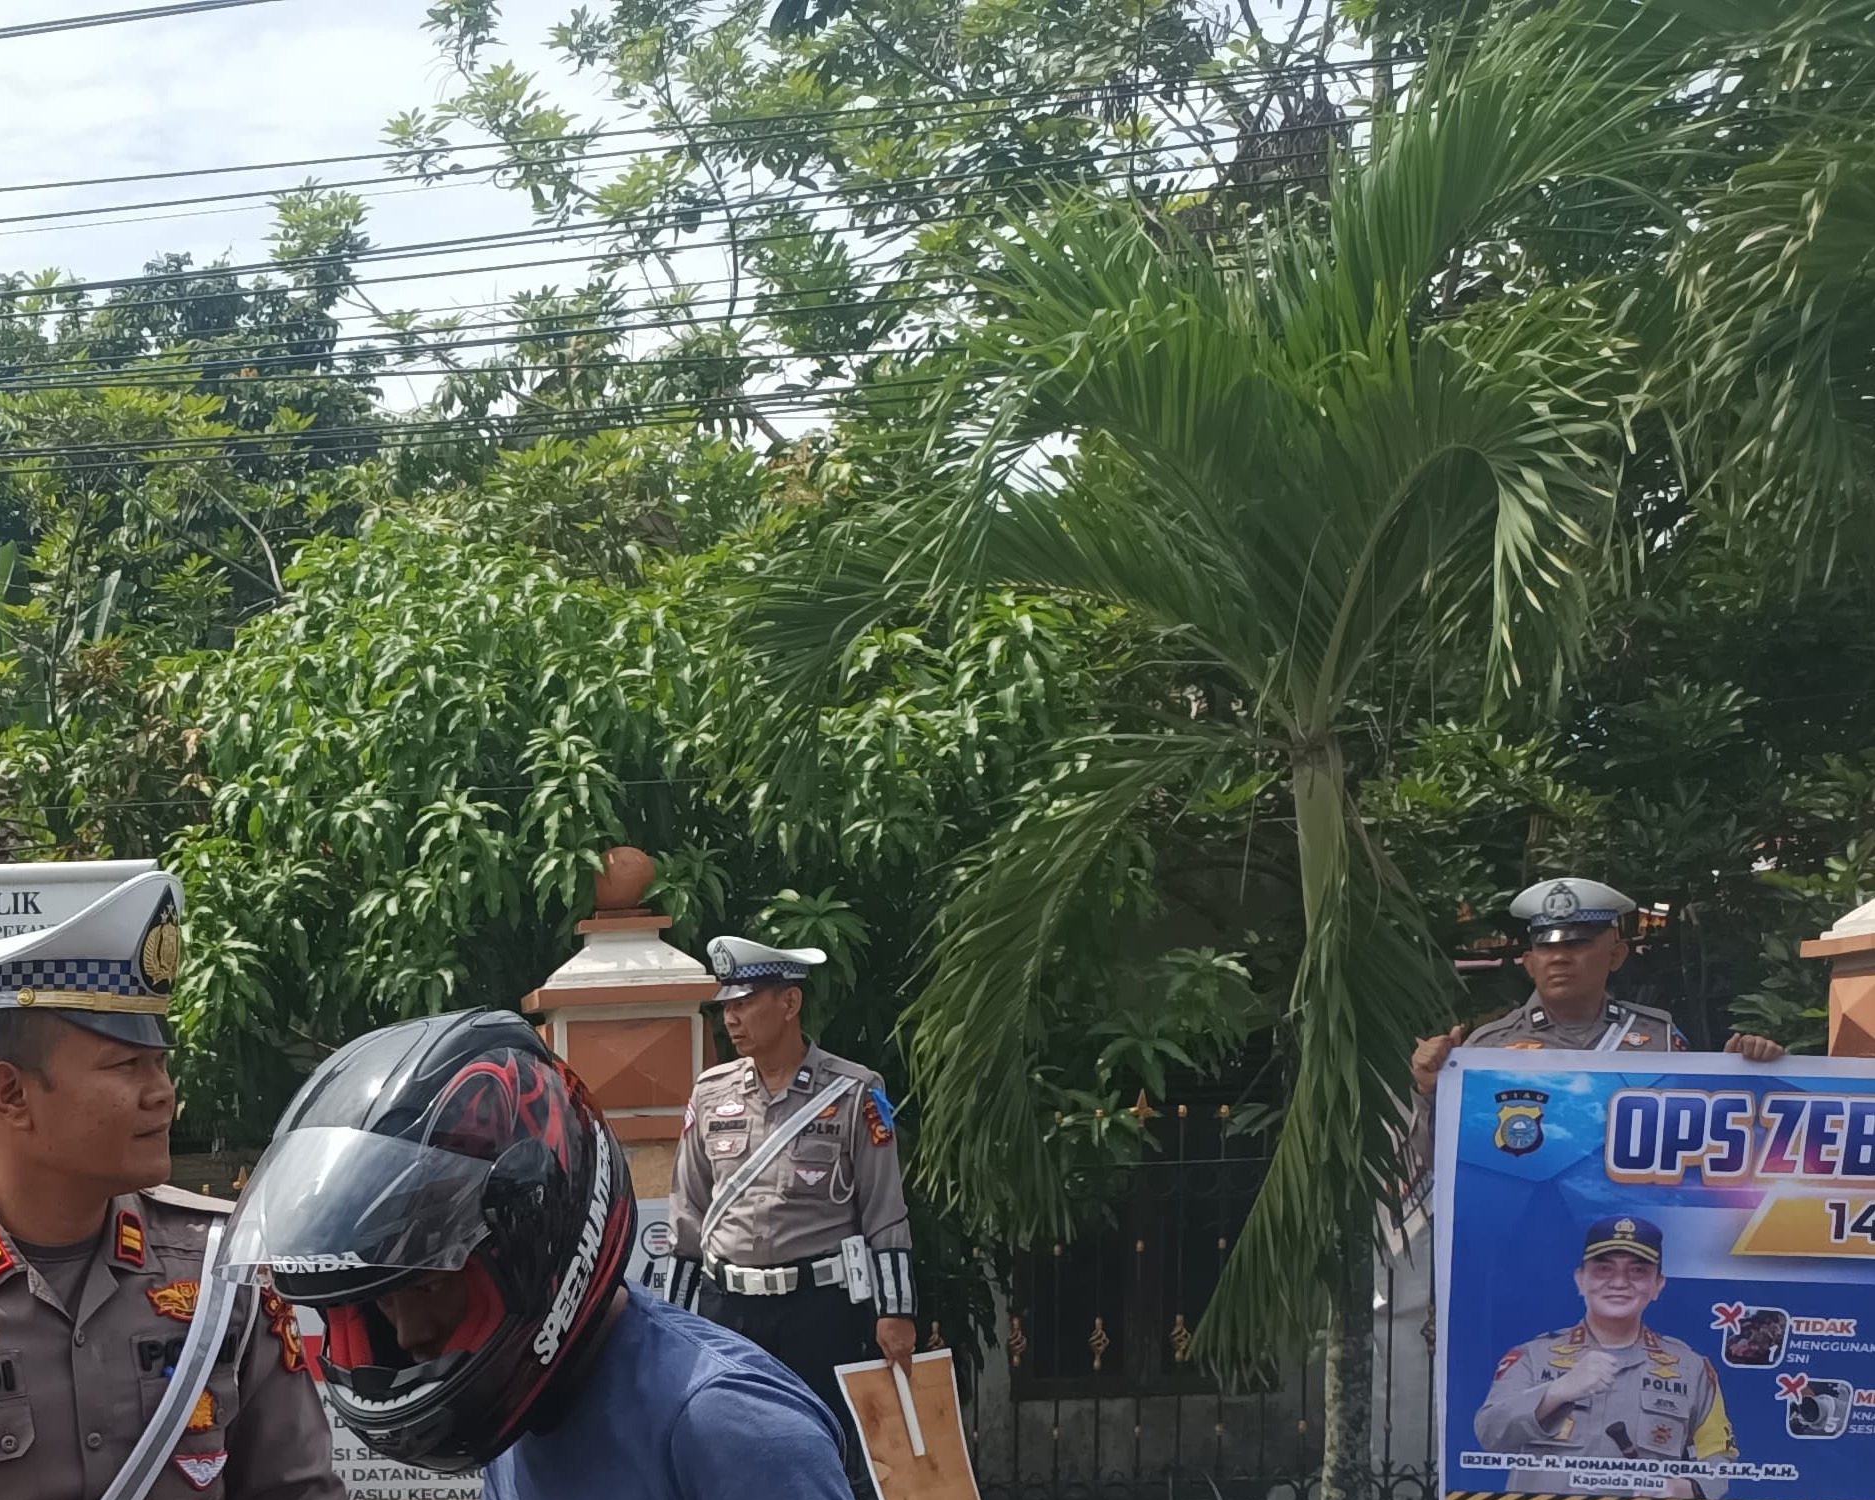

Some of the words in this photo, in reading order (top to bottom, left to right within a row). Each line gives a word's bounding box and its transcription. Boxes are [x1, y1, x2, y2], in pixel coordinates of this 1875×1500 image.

[1608, 1092, 1753, 1178] OPS
[1792, 1318, 1856, 1335] TIDAK
[1786, 1352, 1810, 1364] SNI
[1643, 1377, 1688, 1394] POLRI
[1463, 1454, 1502, 1467] IRJEN
[1506, 1456, 1541, 1468] POL.
[1545, 1458, 1561, 1469] H.
[1565, 1459, 1660, 1474] MOHAMMAD
[1572, 1475, 1629, 1488] Kapolda
[1633, 1477, 1665, 1489] Riau
